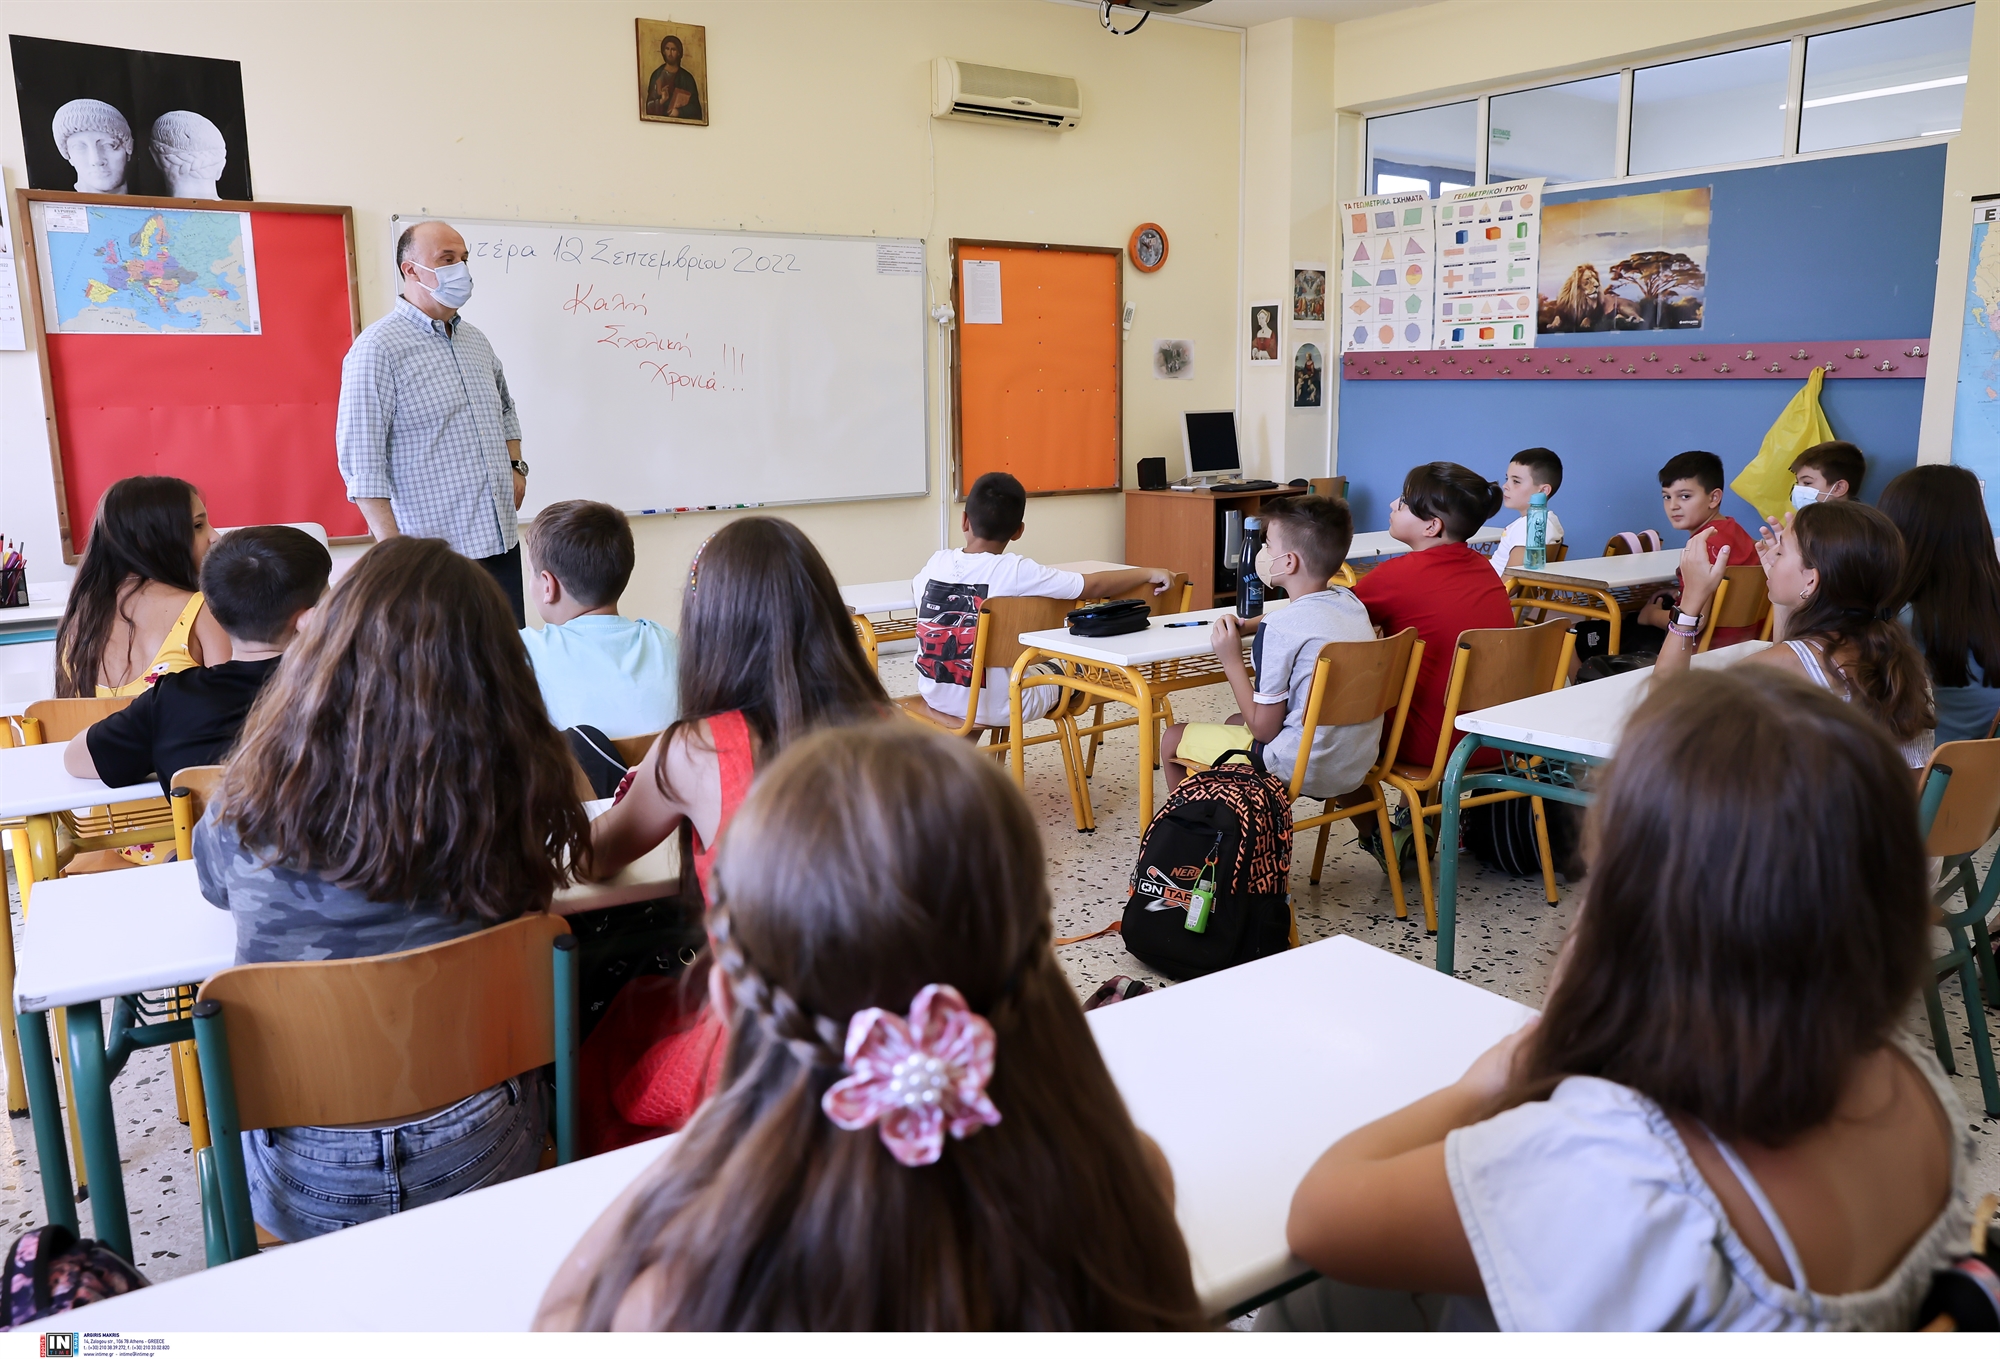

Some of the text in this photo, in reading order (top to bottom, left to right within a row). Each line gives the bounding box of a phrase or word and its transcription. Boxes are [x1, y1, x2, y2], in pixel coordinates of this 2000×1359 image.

[1454, 187, 1502, 200] ΓΕΩΜΕΤΡΙΚΟΙ
[1505, 184, 1528, 193] ΤΥΠΟΙ
[1353, 198, 1391, 209] ΓΕΩΜΕΤΡΙΚΑ
[1392, 194, 1424, 204] ΣΧΗΜΑΤΑ
[468, 239, 537, 274] τέρα
[554, 235, 584, 265] 12
[731, 247, 801, 273] 2022
[1141, 882, 1163, 895] ON
